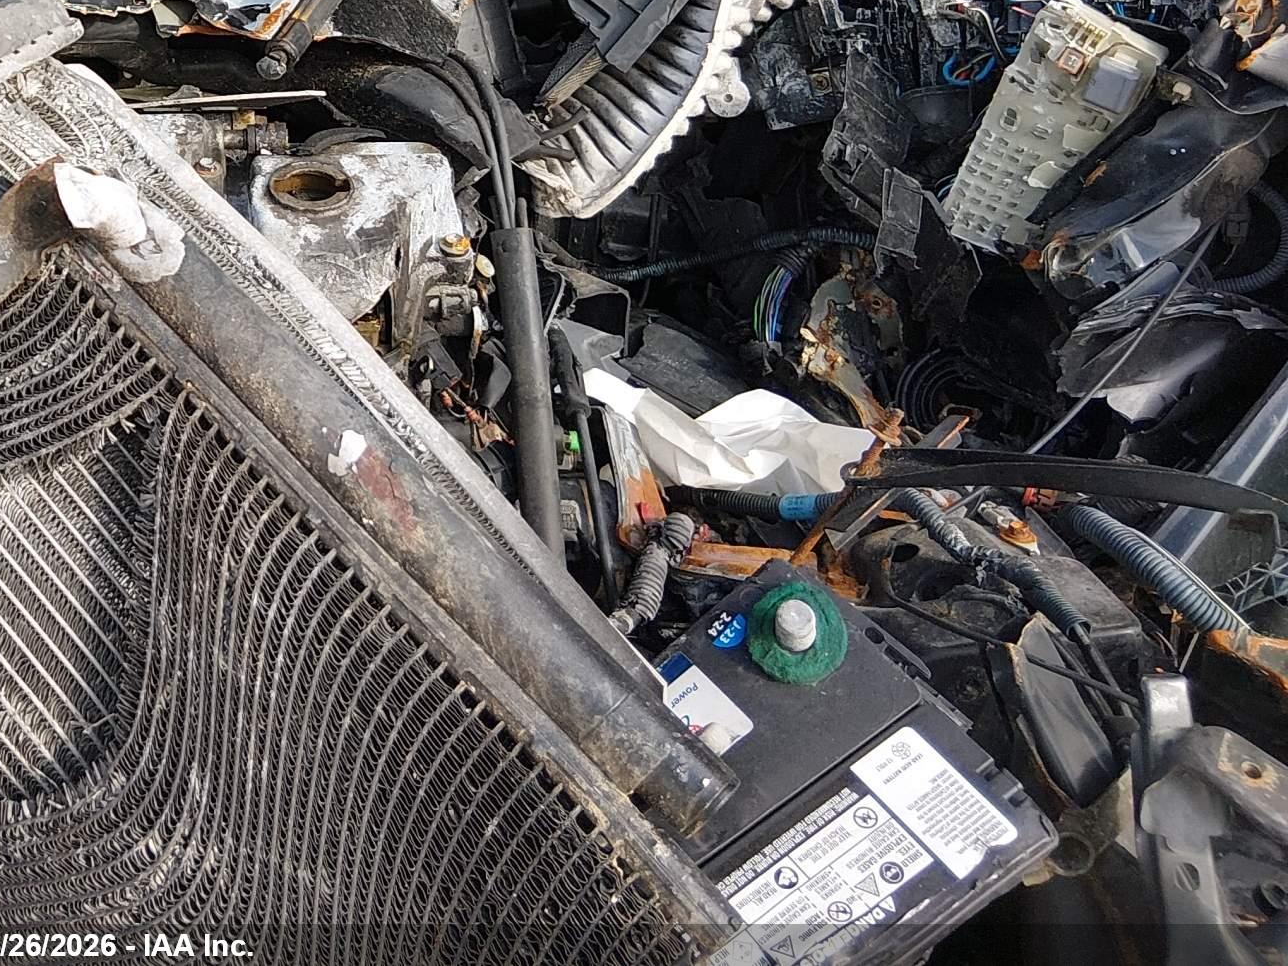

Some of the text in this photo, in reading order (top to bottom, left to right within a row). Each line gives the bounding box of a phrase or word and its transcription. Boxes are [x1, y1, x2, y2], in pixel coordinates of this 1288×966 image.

[707, 611, 733, 637] 2-24
[670, 682, 699, 709] Power
[793, 819, 807, 831] FOR
[776, 831, 806, 854] EXPLOSION
[855, 832, 907, 873] EXPLOSIVE GASES
[741, 852, 764, 871] FOLLOW
[899, 848, 923, 868] SHIELD
[722, 866, 745, 885] PROPER
[734, 875, 748, 886] NOT
[744, 869, 755, 879] DO
[734, 880, 772, 909] INSTRUCTIONS
[752, 886, 777, 906] READ ALL
[804, 912, 821, 926] ACID
[797, 918, 827, 942] SULFURIC
[711, 947, 730, 964] HELP
